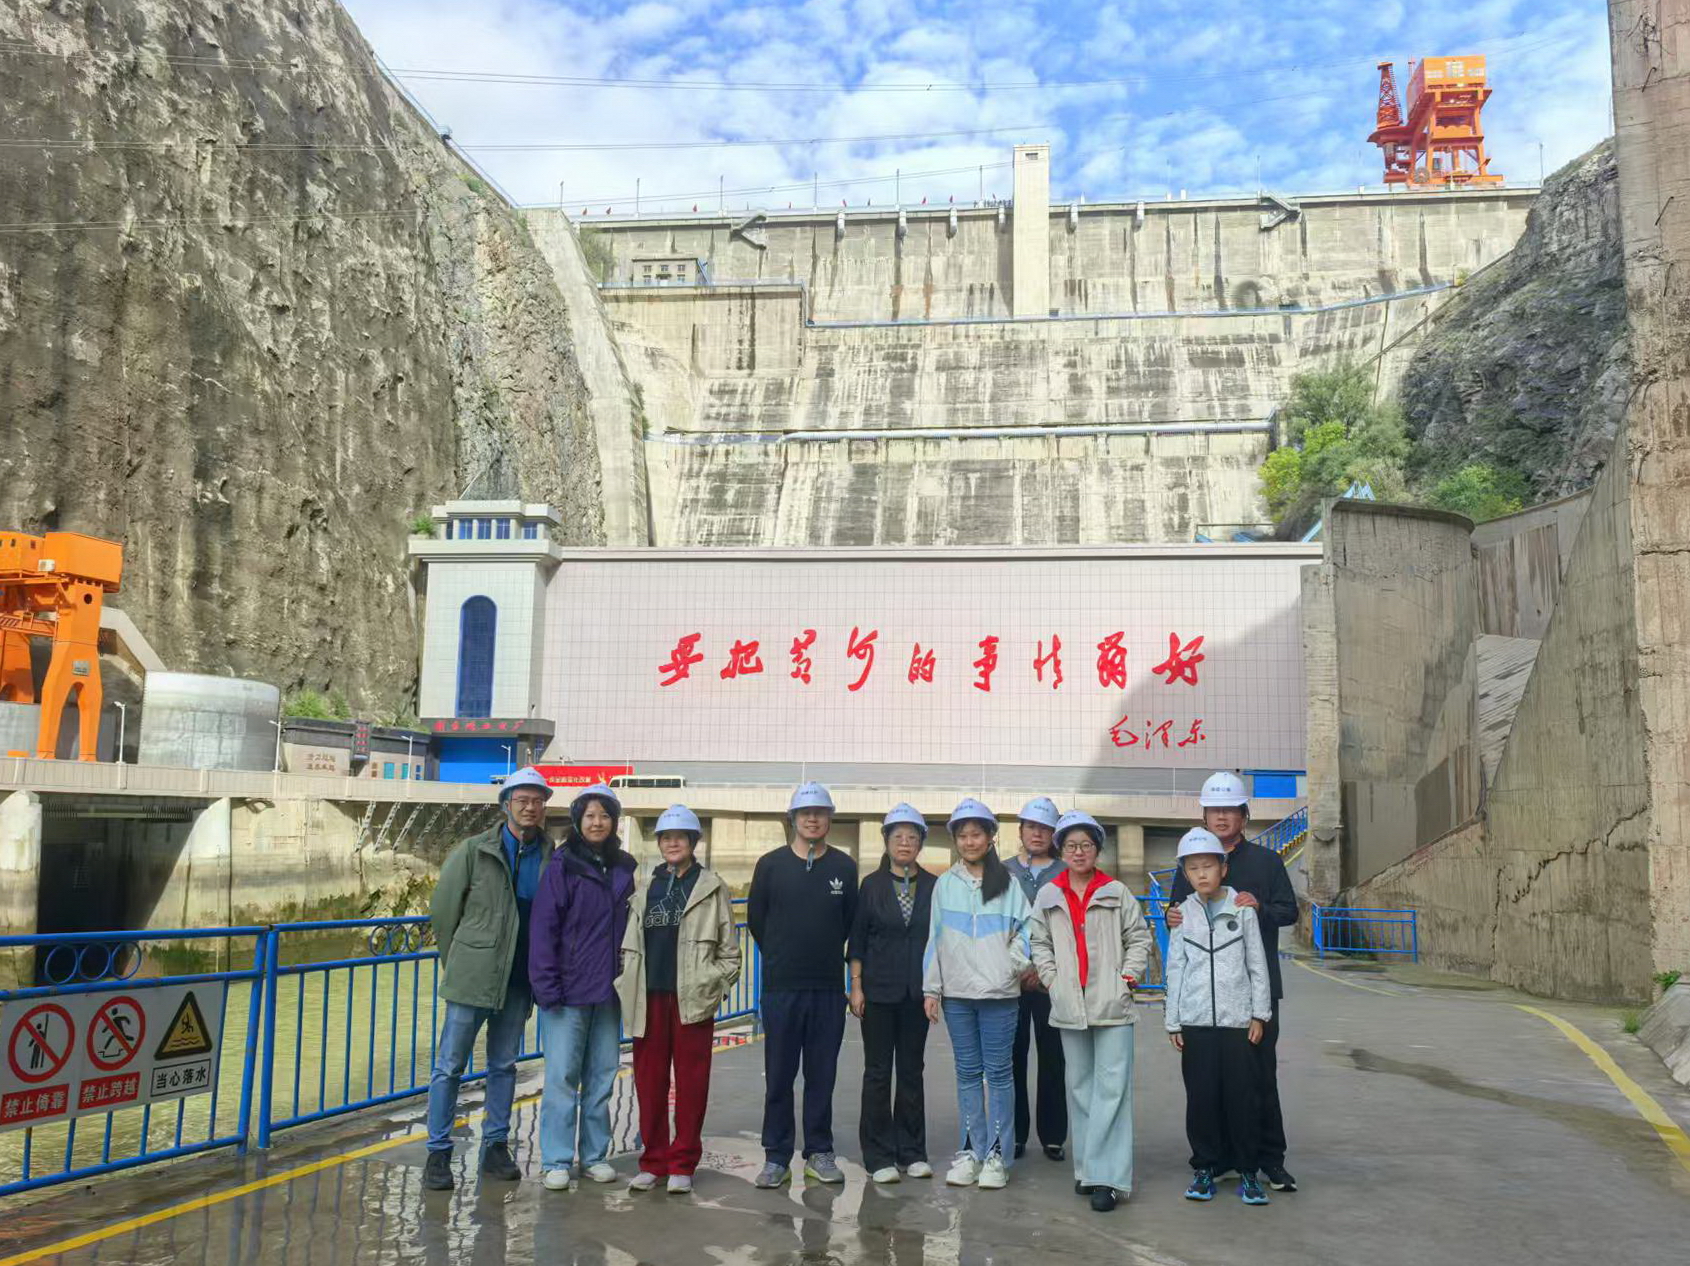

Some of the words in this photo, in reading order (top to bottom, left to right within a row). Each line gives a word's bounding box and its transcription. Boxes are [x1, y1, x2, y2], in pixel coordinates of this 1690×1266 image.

[82, 1078, 138, 1103] 禁止跨越
[156, 1068, 207, 1090] 当心落水
[4, 1090, 66, 1118] 禁止倚靠
